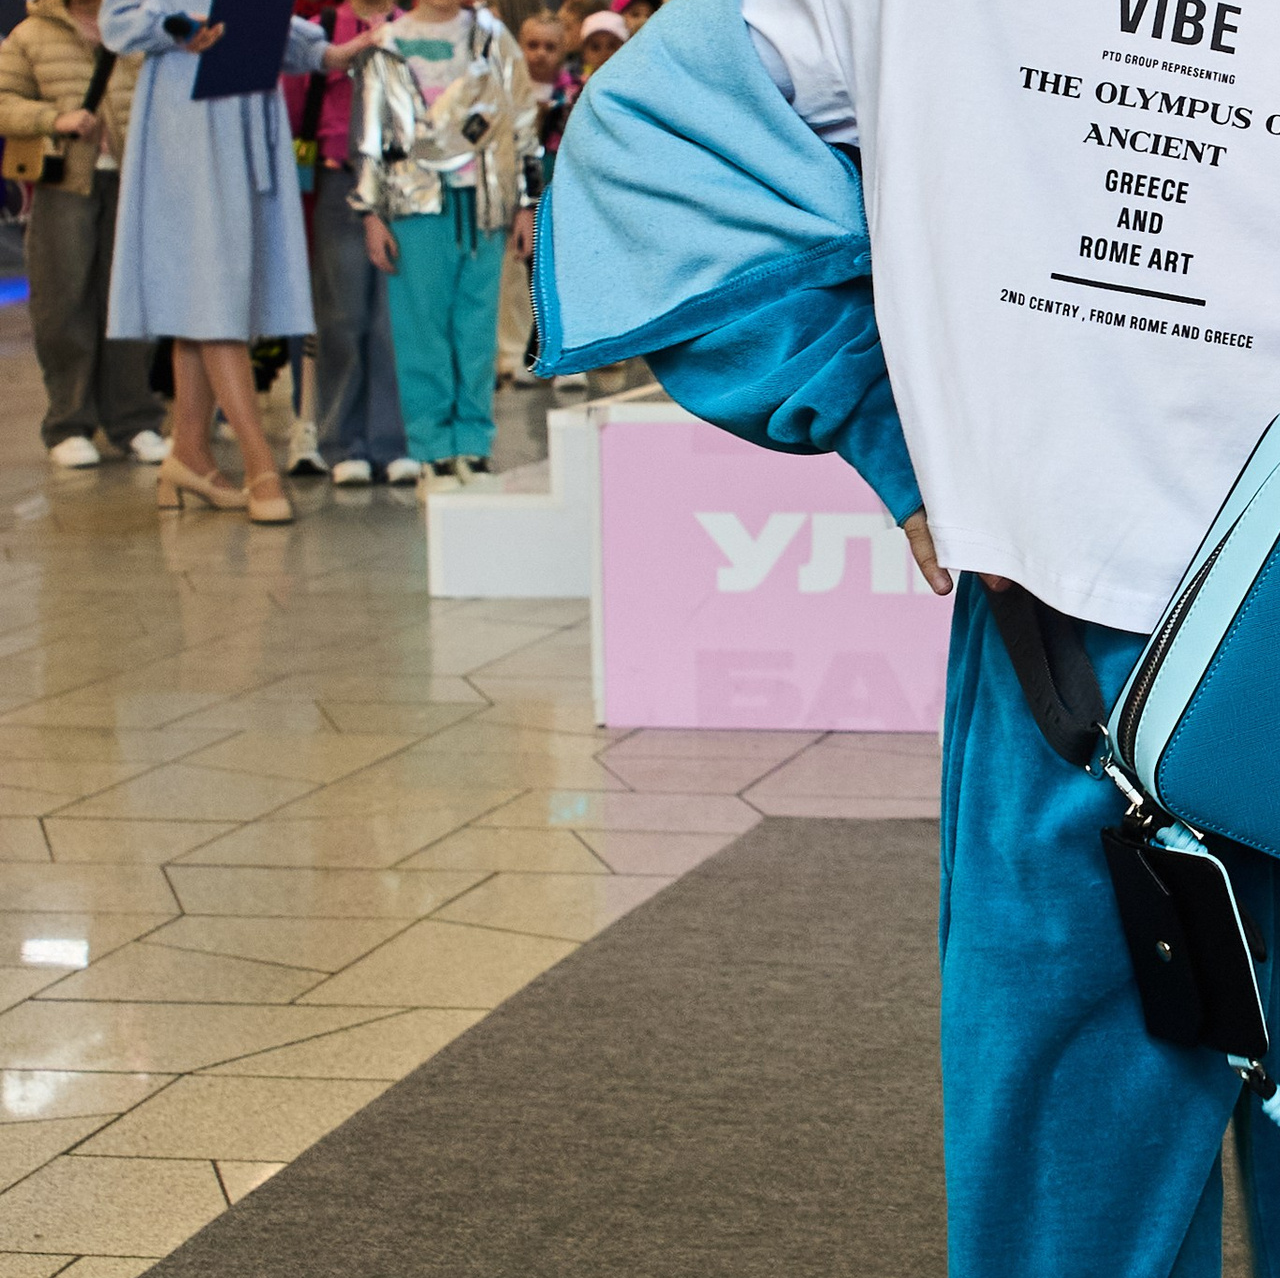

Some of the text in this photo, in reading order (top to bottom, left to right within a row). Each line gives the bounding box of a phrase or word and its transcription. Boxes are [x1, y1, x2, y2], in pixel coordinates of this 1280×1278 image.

[1101, 50, 1237, 85] PTD GROUP REPRESENTING
[1019, 66, 1083, 99] THE
[1095, 81, 1253, 130] OLYMPUS
[1082, 122, 1228, 167] ANCIENT
[1105, 169, 1190, 204] GREECE
[1116, 206, 1164, 235] AND
[1079, 235, 1195, 275] ROME ART
[999, 288, 1026, 306] 2ND
[1089, 308, 1127, 328] FROM
[1129, 315, 1169, 335] ROME
[1171, 323, 1200, 340] AND
[1204, 328, 1254, 349] GREECE
